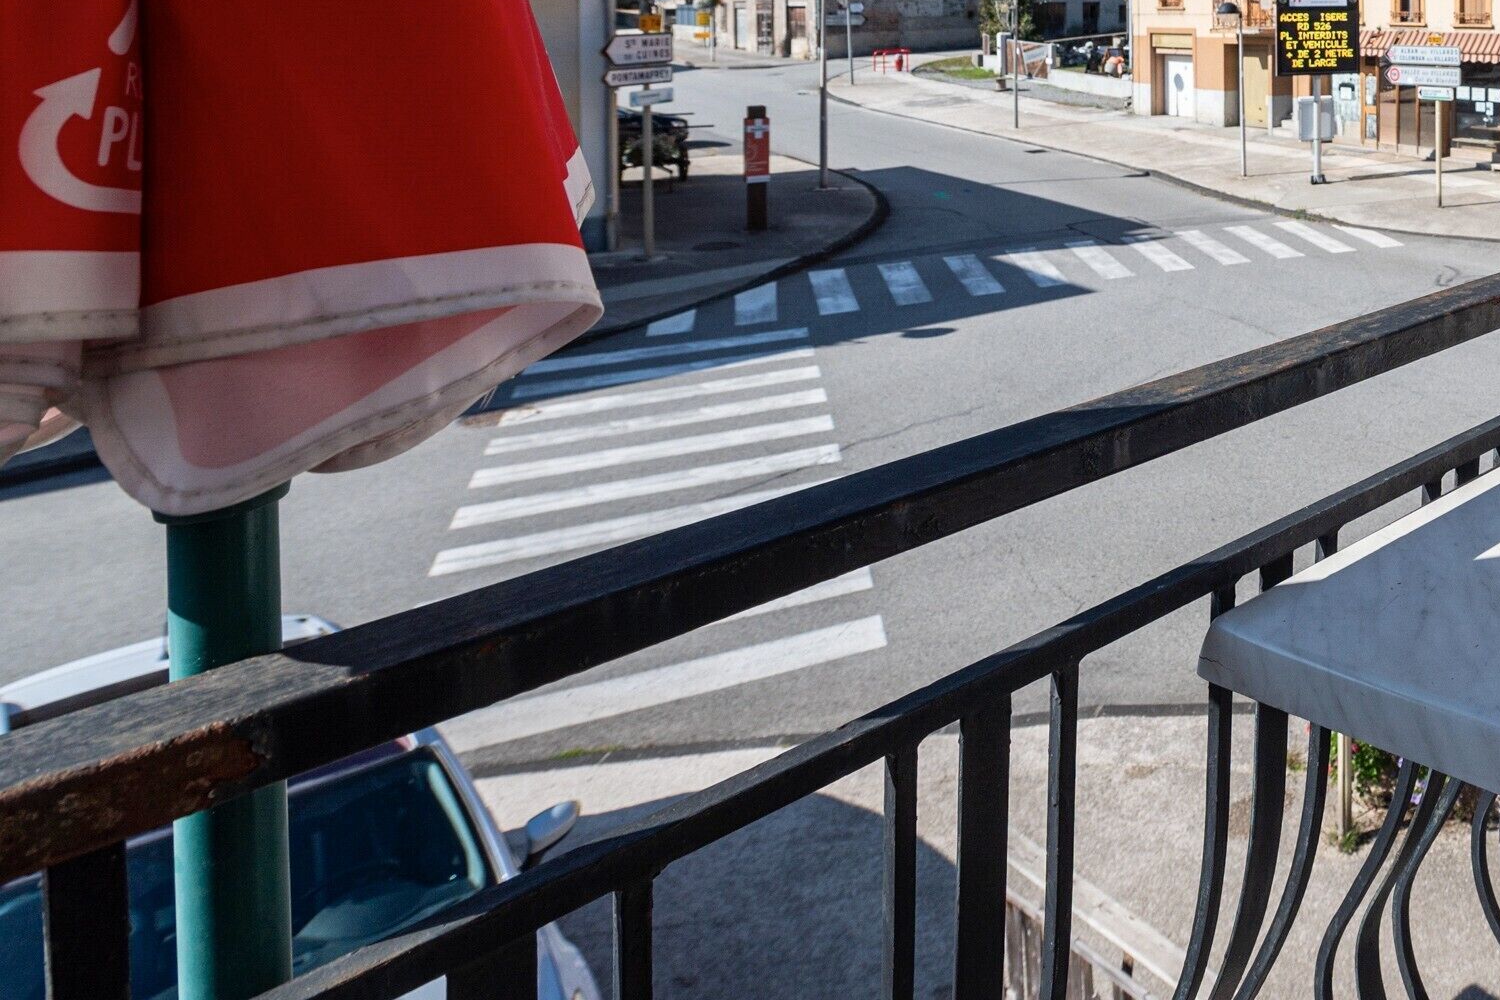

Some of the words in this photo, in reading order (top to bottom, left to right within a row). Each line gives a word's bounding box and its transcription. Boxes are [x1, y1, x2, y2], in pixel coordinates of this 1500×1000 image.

[1280, 13, 1310, 22] ACCES
[1320, 13, 1348, 22] ISERE
[1297, 22, 1310, 31] RD
[1313, 22, 1332, 31] 526
[1280, 31, 1293, 41] PL
[1298, 31, 1348, 40] INTERDITS
[642, 38, 669, 47] MARIE
[1286, 41, 1298, 50] ET
[1303, 40, 1348, 49] VEHICULE
[1297, 50, 1310, 59] DE
[1314, 50, 1321, 59] 2
[1325, 49, 1354, 58] METRE
[1292, 59, 1304, 68] DE
[1308, 59, 1337, 68] LARGE
